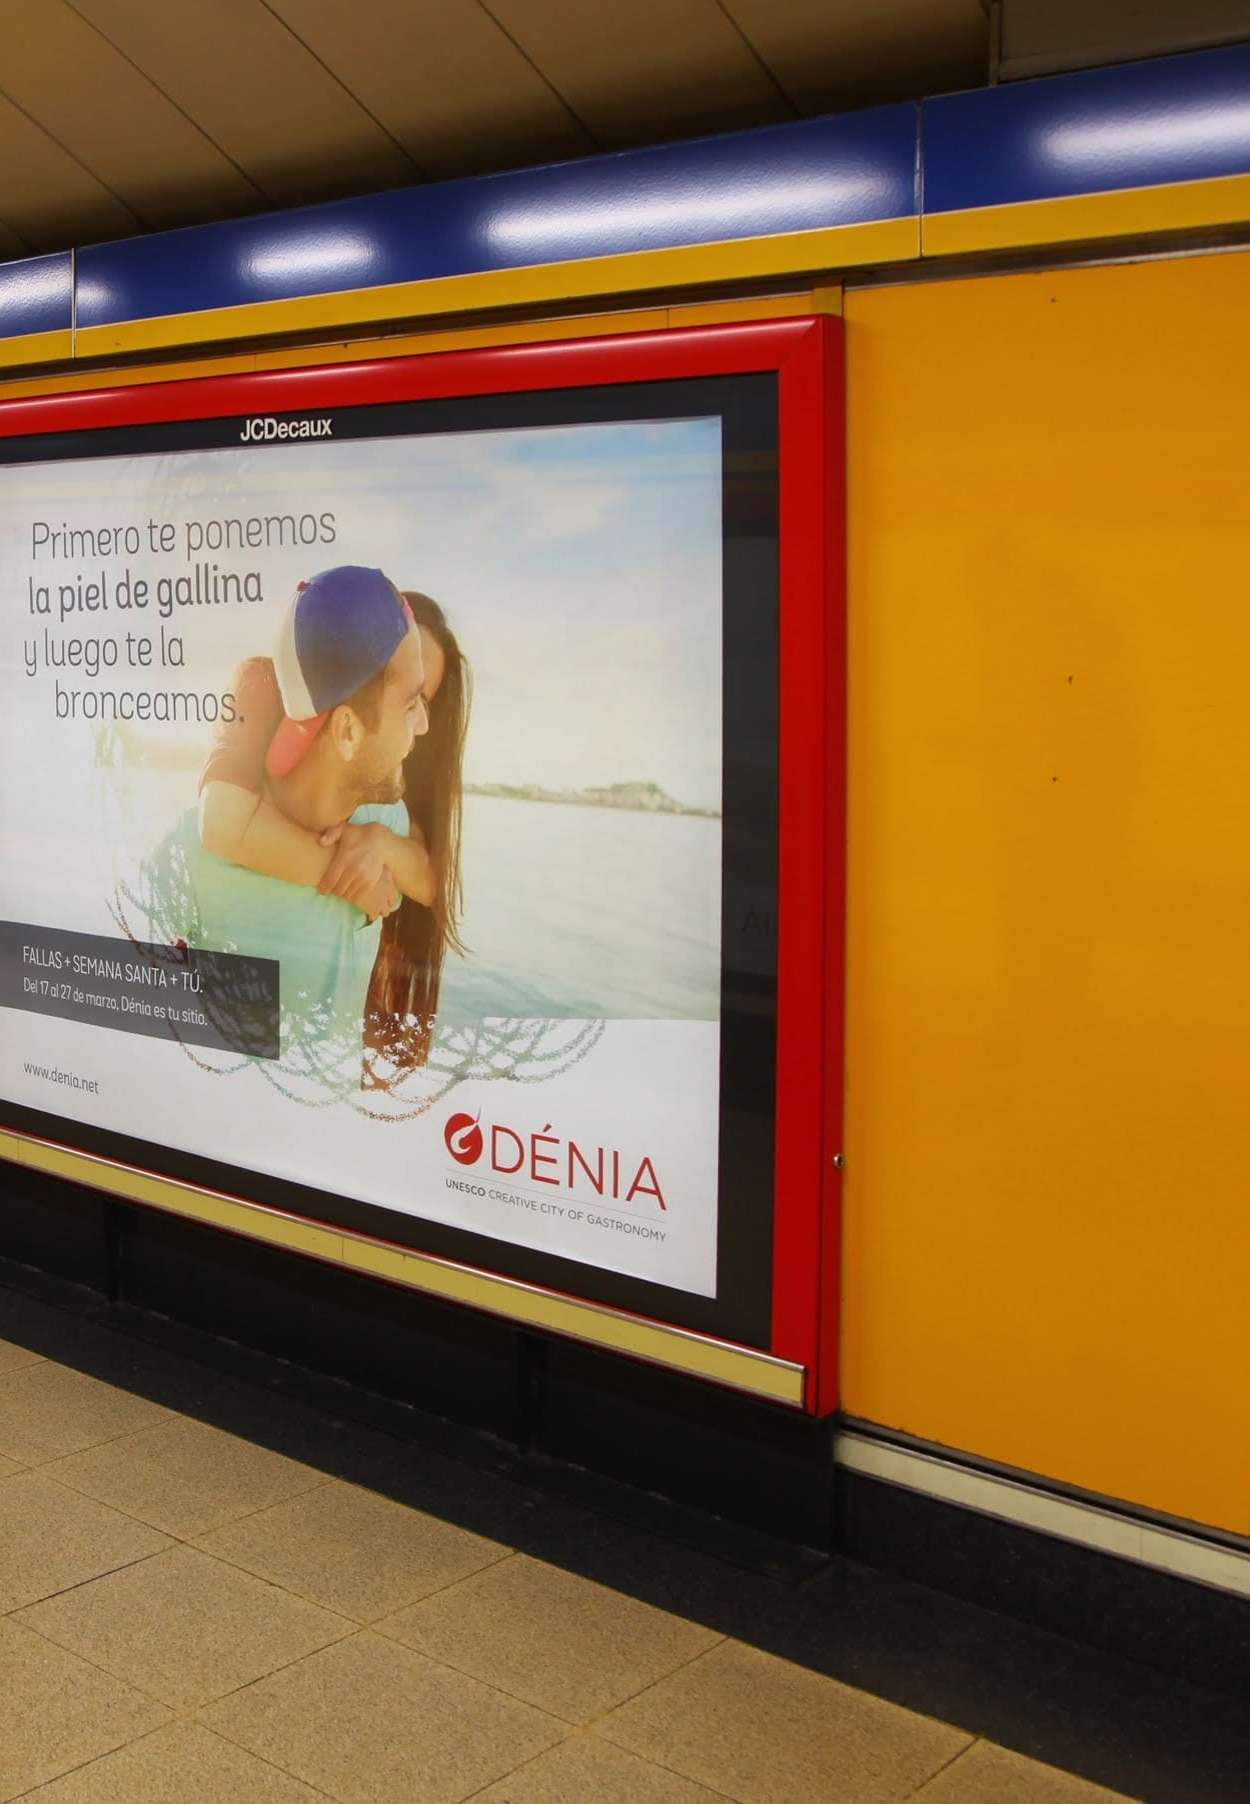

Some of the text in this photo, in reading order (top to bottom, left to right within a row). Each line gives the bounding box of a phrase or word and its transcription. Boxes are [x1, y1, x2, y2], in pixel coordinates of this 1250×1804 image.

[239, 417, 333, 442] JCDecaux
[32, 512, 337, 562] Primero te ponemos
[28, 562, 264, 622] la piel de gallina
[23, 626, 186, 677] y luego te la
[54, 679, 246, 723] bronceamos.
[23, 945, 63, 970] FALLAS
[72, 954, 123, 981] SEMANA
[124, 963, 168, 988] SANTA
[181, 968, 204, 994] TÚ.
[23, 976, 208, 1026] Del 17 al 27 de marzo, Dénia es tu sitio.
[23, 1060, 100, 1095] www.denia.net
[491, 1123, 667, 1211] DÉNIA
[445, 1178, 667, 1243] UNESCO CREATIVE CITY OF GASTRONOMY
